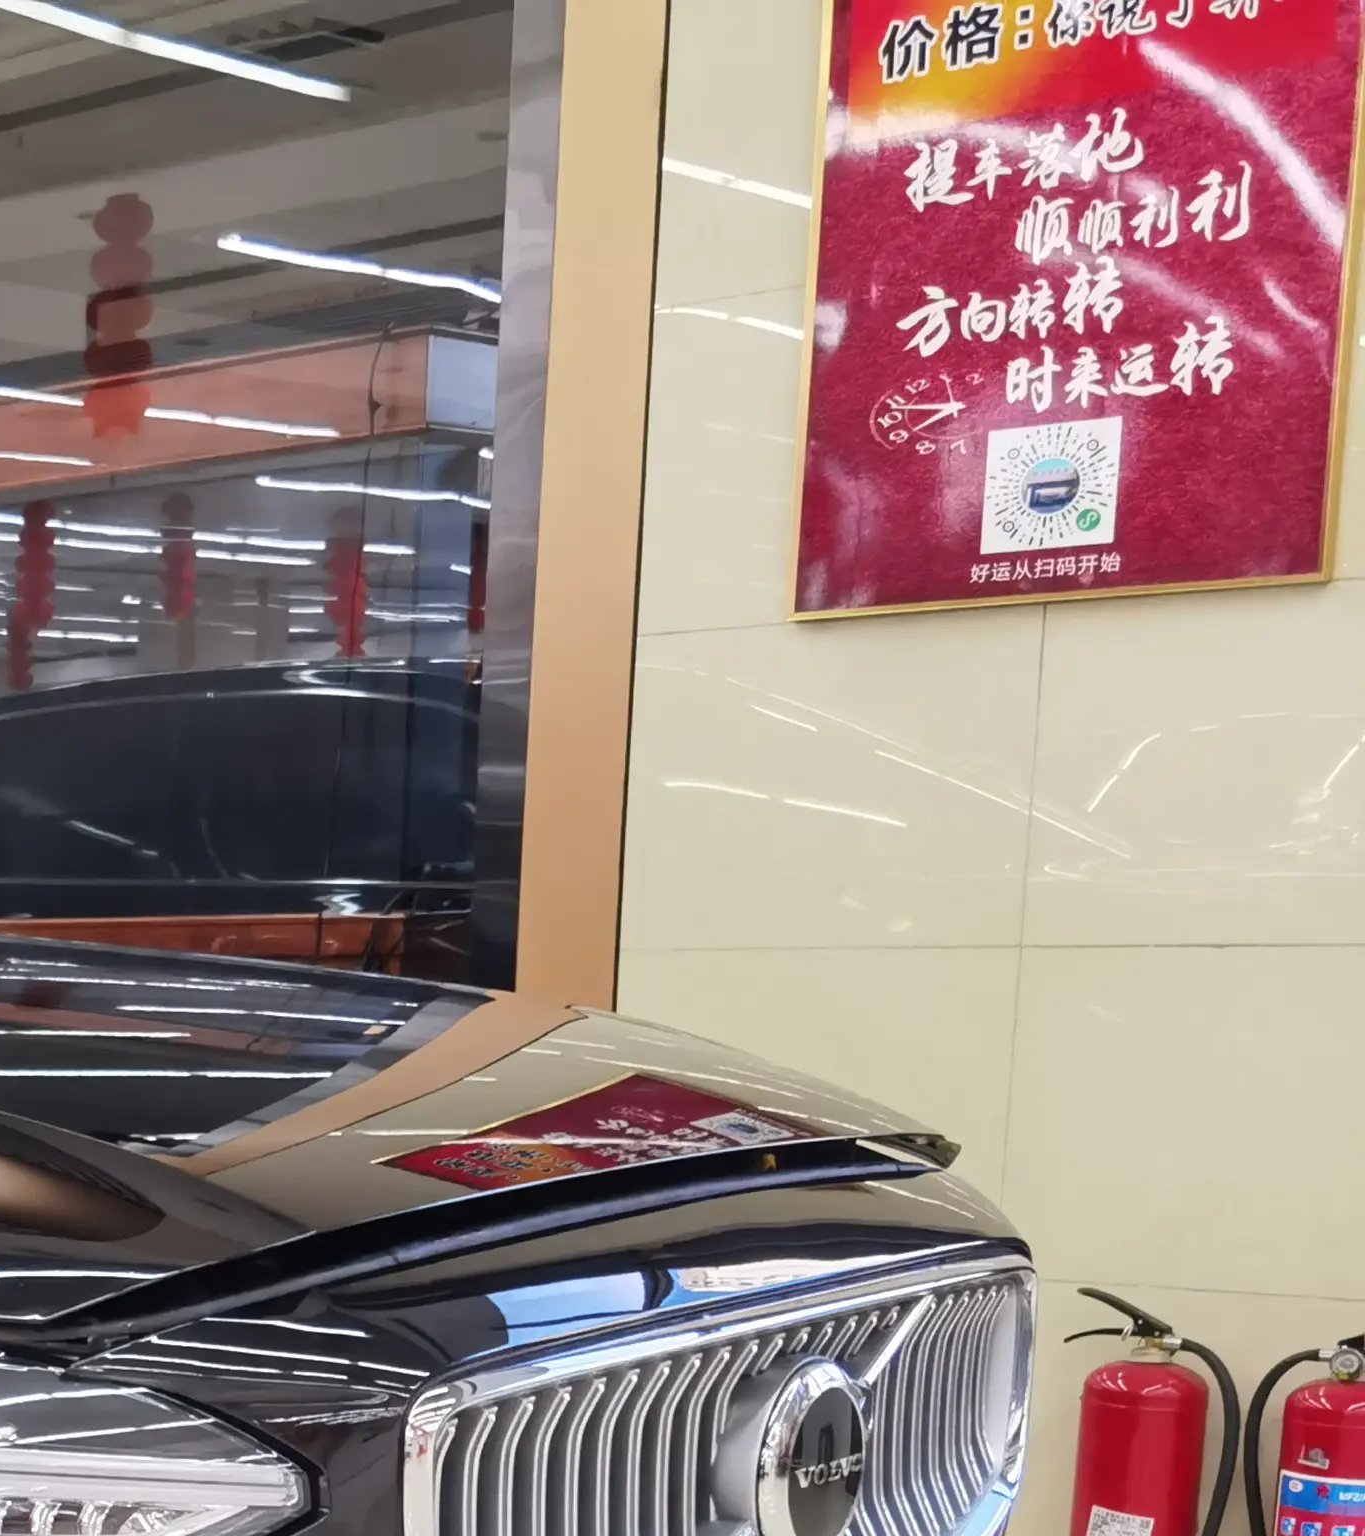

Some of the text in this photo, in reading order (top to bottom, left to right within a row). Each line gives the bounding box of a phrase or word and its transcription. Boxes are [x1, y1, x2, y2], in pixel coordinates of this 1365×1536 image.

[904, 107, 1143, 213] 提车落地
[1014, 160, 1253, 266] 顺顺利利
[896, 255, 1125, 358] 方向转转
[1005, 316, 1236, 414] 时来运转
[969, 551, 1121, 584] 好运从扫码开始
[794, 1453, 862, 1489] VOLVO
